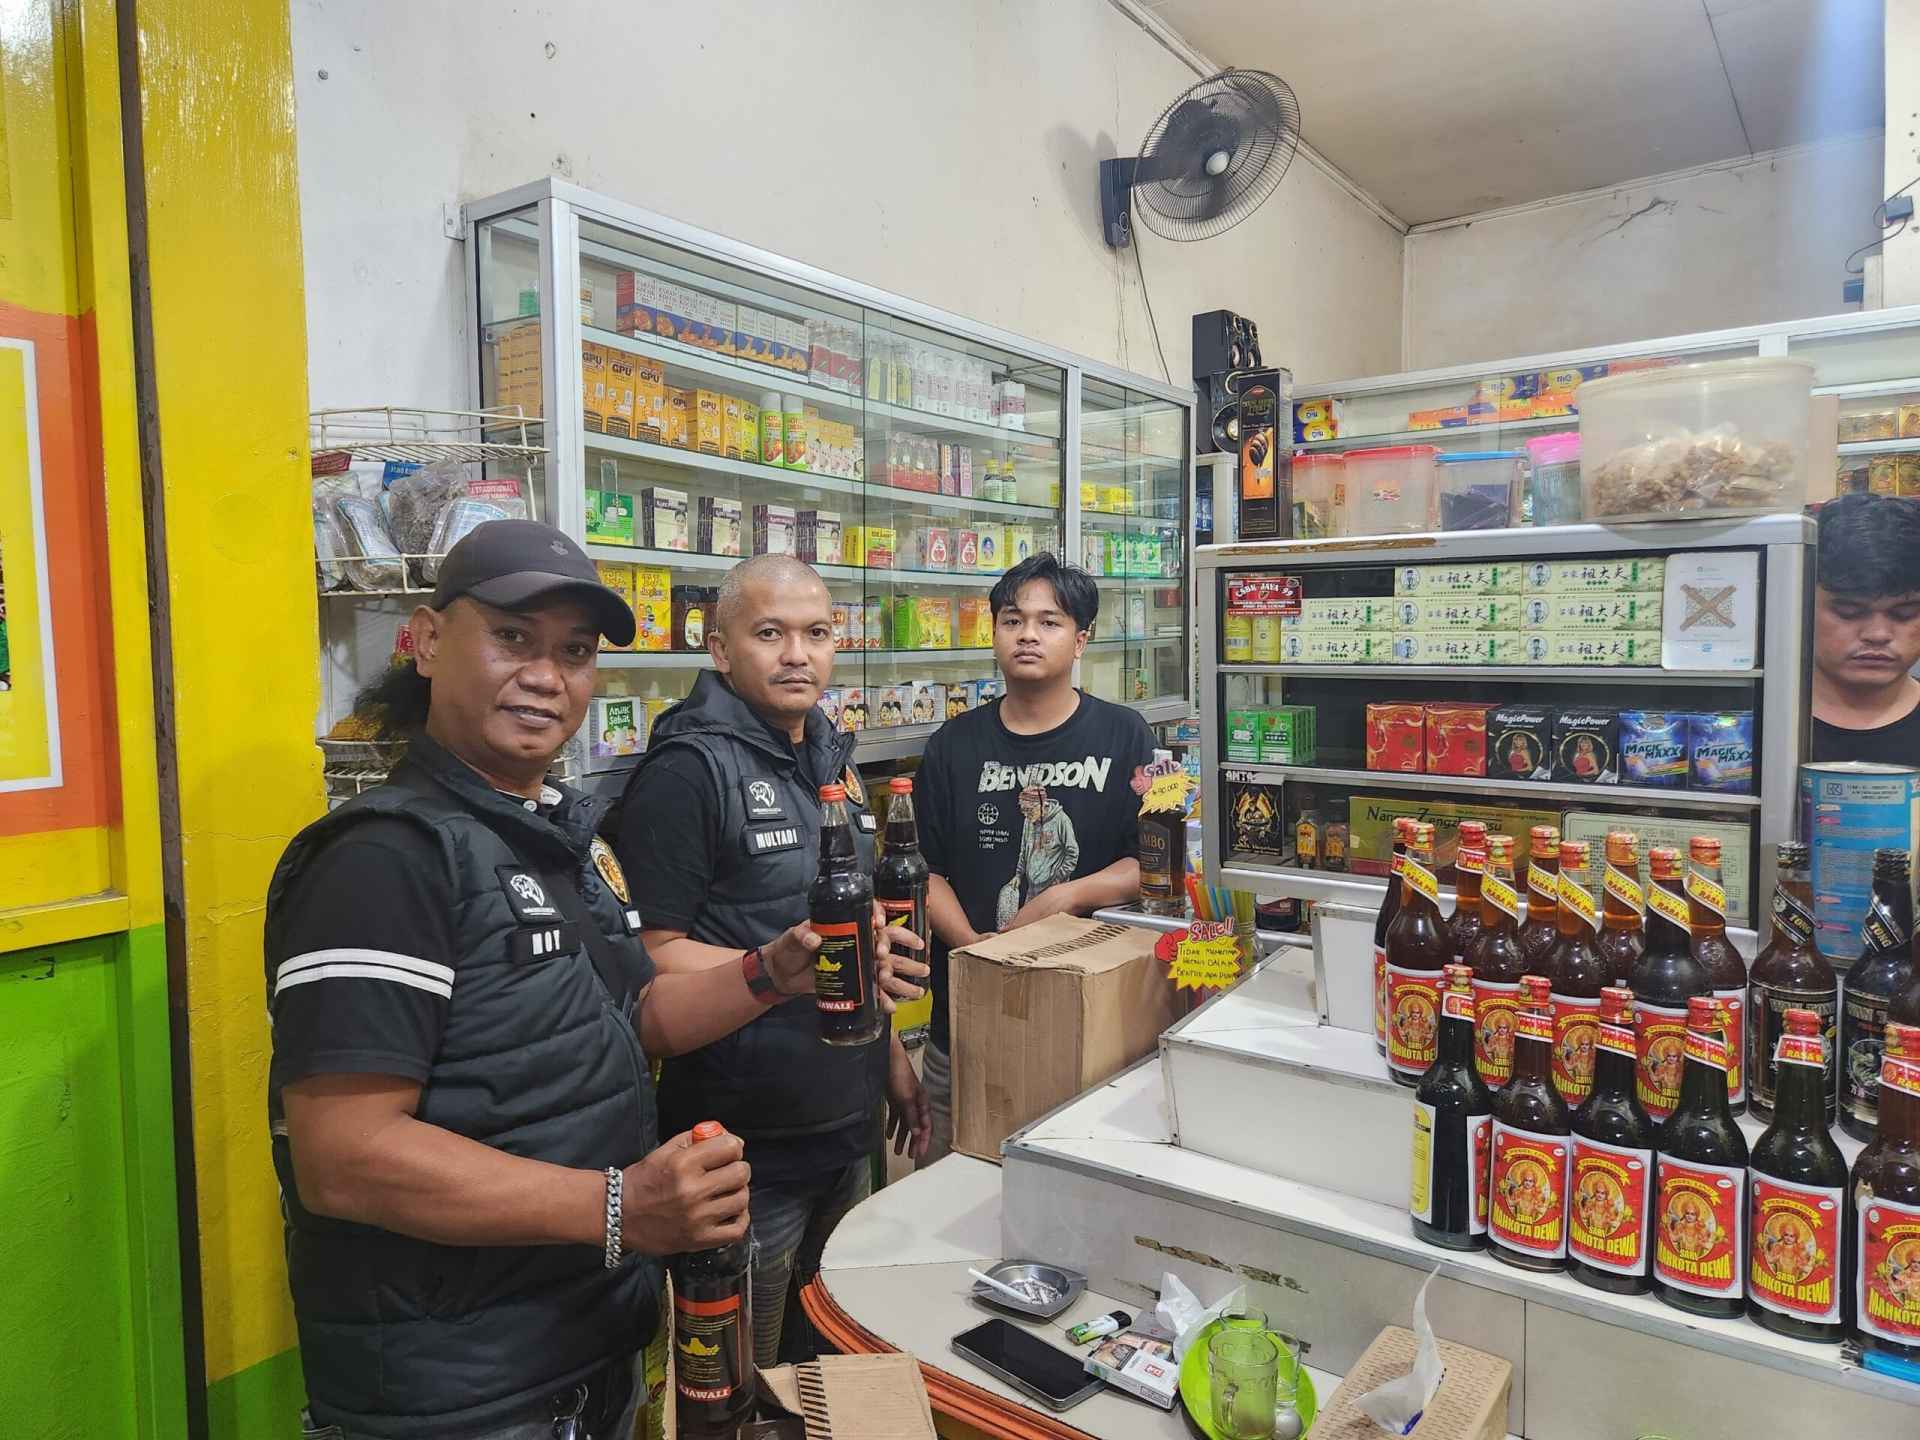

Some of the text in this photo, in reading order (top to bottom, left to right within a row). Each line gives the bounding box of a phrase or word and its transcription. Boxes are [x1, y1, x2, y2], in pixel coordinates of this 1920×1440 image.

[612, 363, 632, 377] GPU
[640, 371, 659, 384] GPU
[700, 400, 717, 410] GPU
[1495, 713, 1545, 725] MagicPower
[1559, 715, 1610, 727] MagicPower
[1624, 743, 1661, 756] MAGIC
[1644, 745, 1682, 760] MAXX
[1695, 745, 1736, 759] MAGIC
[755, 828, 798, 849] MULYADI
[1870, 922, 1892, 948] TONG
[1493, 1200, 1560, 1241] MAHKOTA DEWA
[1572, 1219, 1636, 1257] MAHKOTA DEWA
[1657, 1237, 1731, 1279] MAHKOTA DEWA
[1751, 1256, 1830, 1305] MAHKOTA DEWA
[1904, 1299, 1920, 1311] SAR
